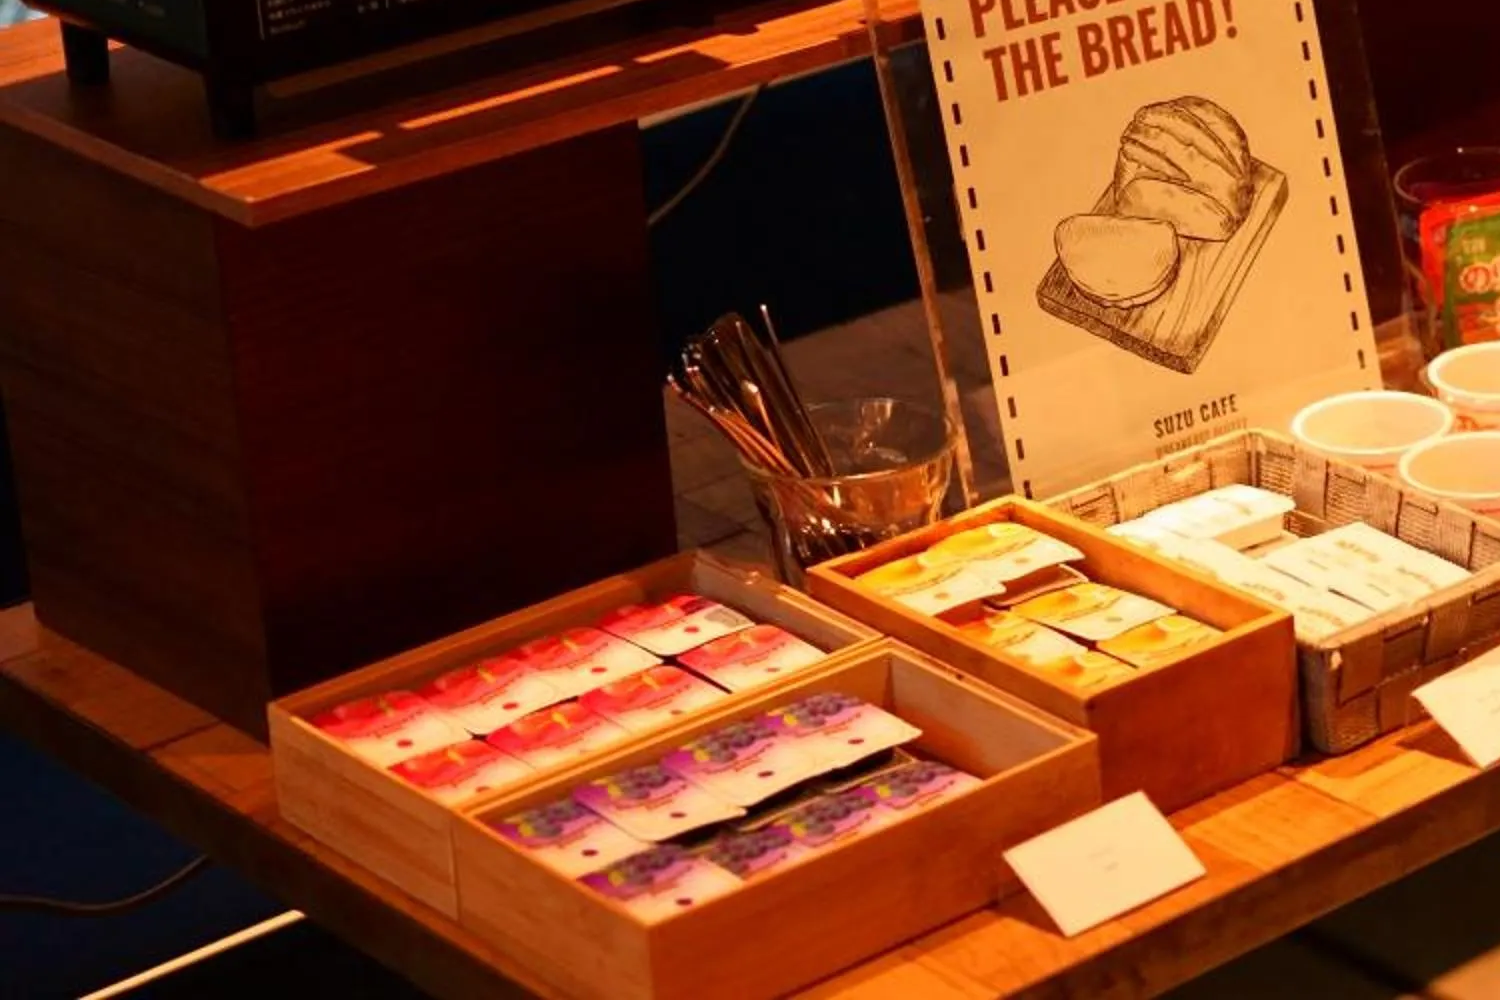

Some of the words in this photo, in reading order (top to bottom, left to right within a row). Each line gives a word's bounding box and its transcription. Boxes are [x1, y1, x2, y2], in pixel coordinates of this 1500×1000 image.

[983, 31, 1069, 102] THE
[1153, 408, 1194, 438] SUZU
[1200, 393, 1238, 422] CAFE
